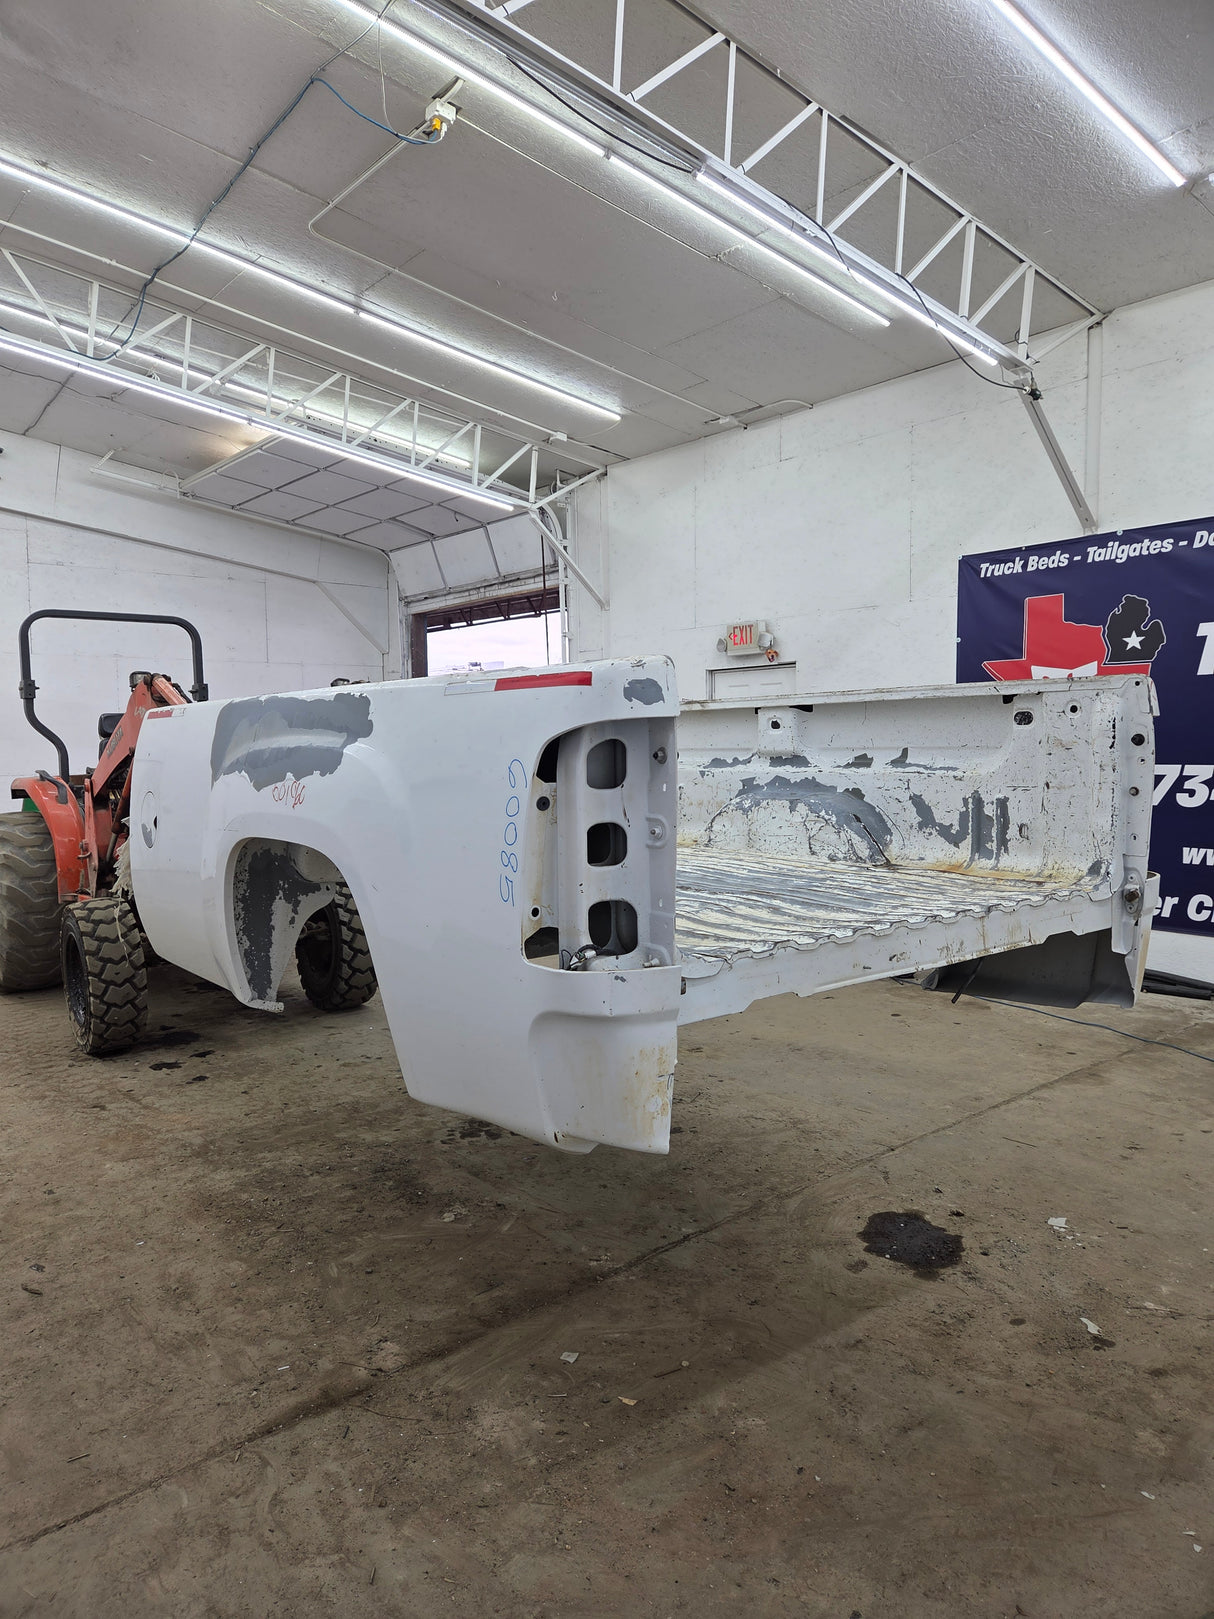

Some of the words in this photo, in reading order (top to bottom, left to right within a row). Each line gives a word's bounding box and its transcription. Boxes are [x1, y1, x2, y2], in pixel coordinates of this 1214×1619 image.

[980, 557, 1024, 578] Truck
[1026, 550, 1070, 572] Beds
[1086, 538, 1174, 563] Tailgates
[733, 624, 753, 646] EXIT
[1152, 764, 1214, 808] 73
[500, 759, 527, 907] 60085
[1187, 894, 1214, 923] C
